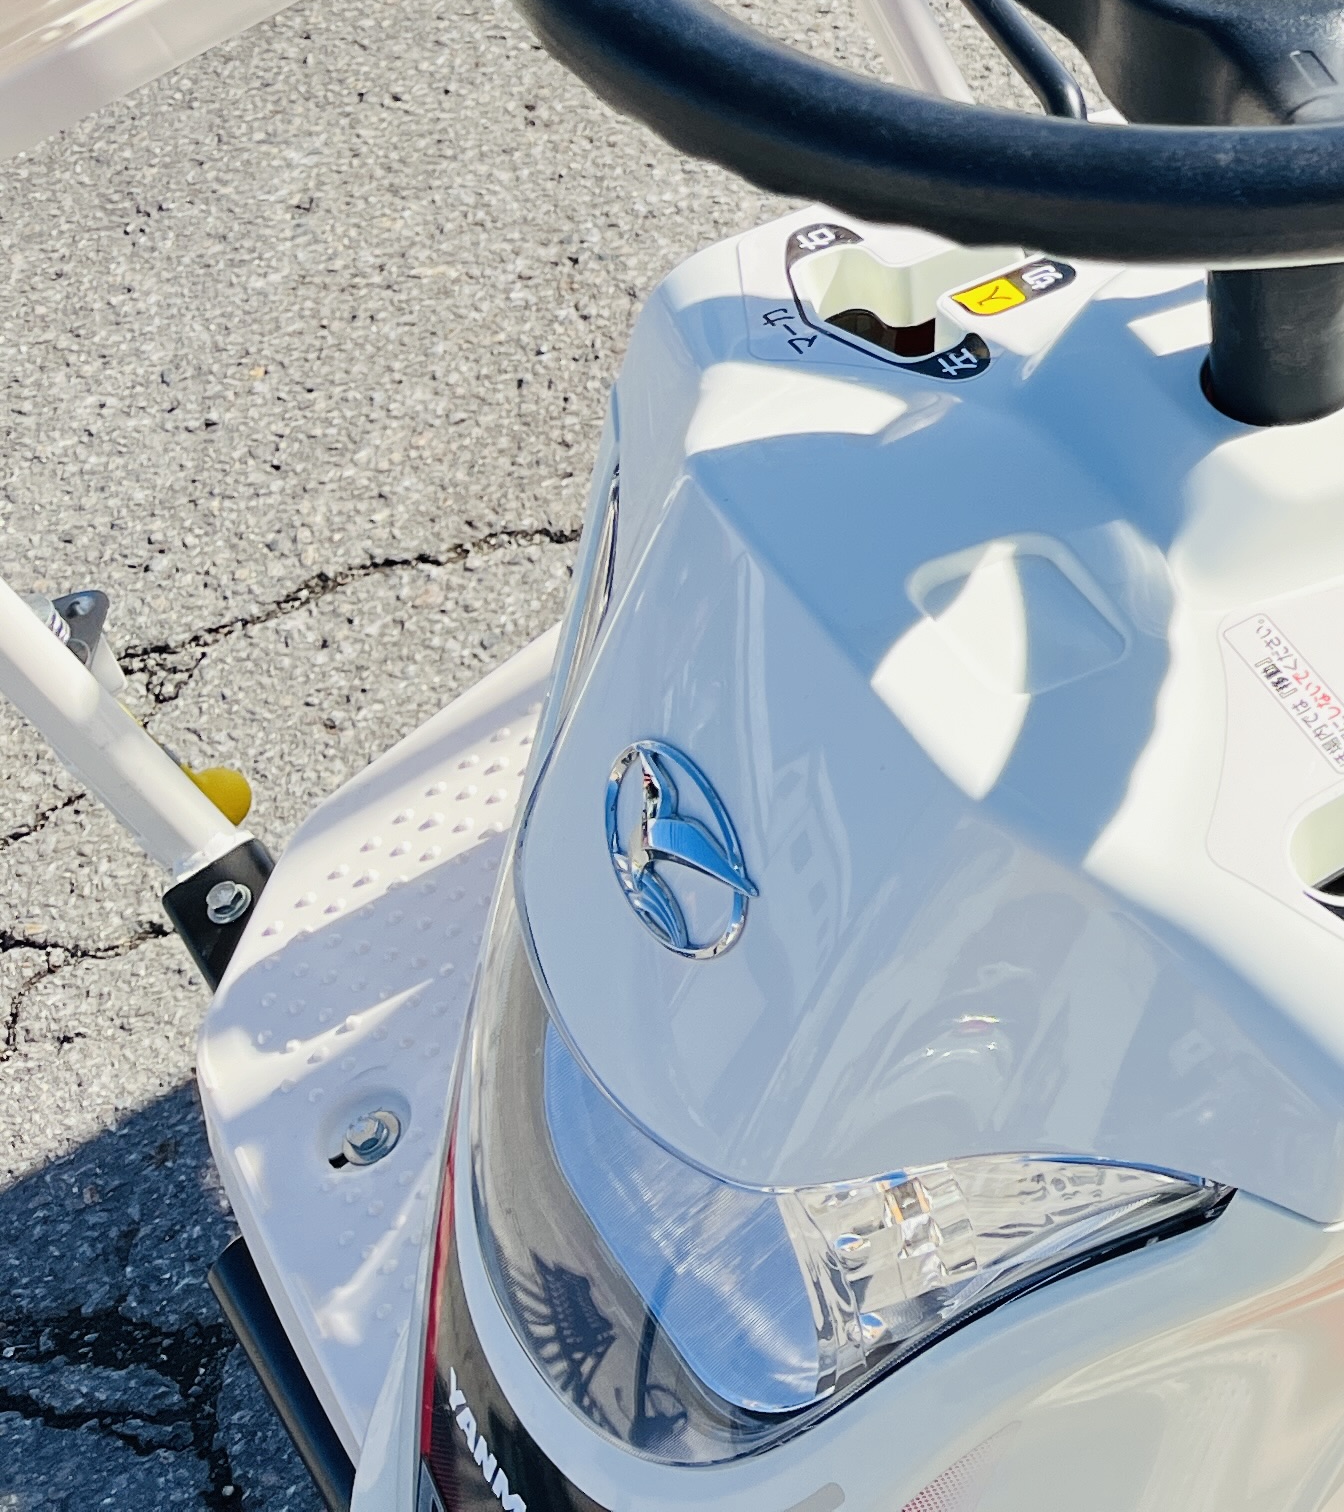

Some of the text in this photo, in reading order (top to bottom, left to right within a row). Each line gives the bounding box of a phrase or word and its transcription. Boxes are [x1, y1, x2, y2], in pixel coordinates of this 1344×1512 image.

[797, 228, 836, 251] 右
[763, 308, 817, 354] マーカ
[938, 348, 978, 376] 左
